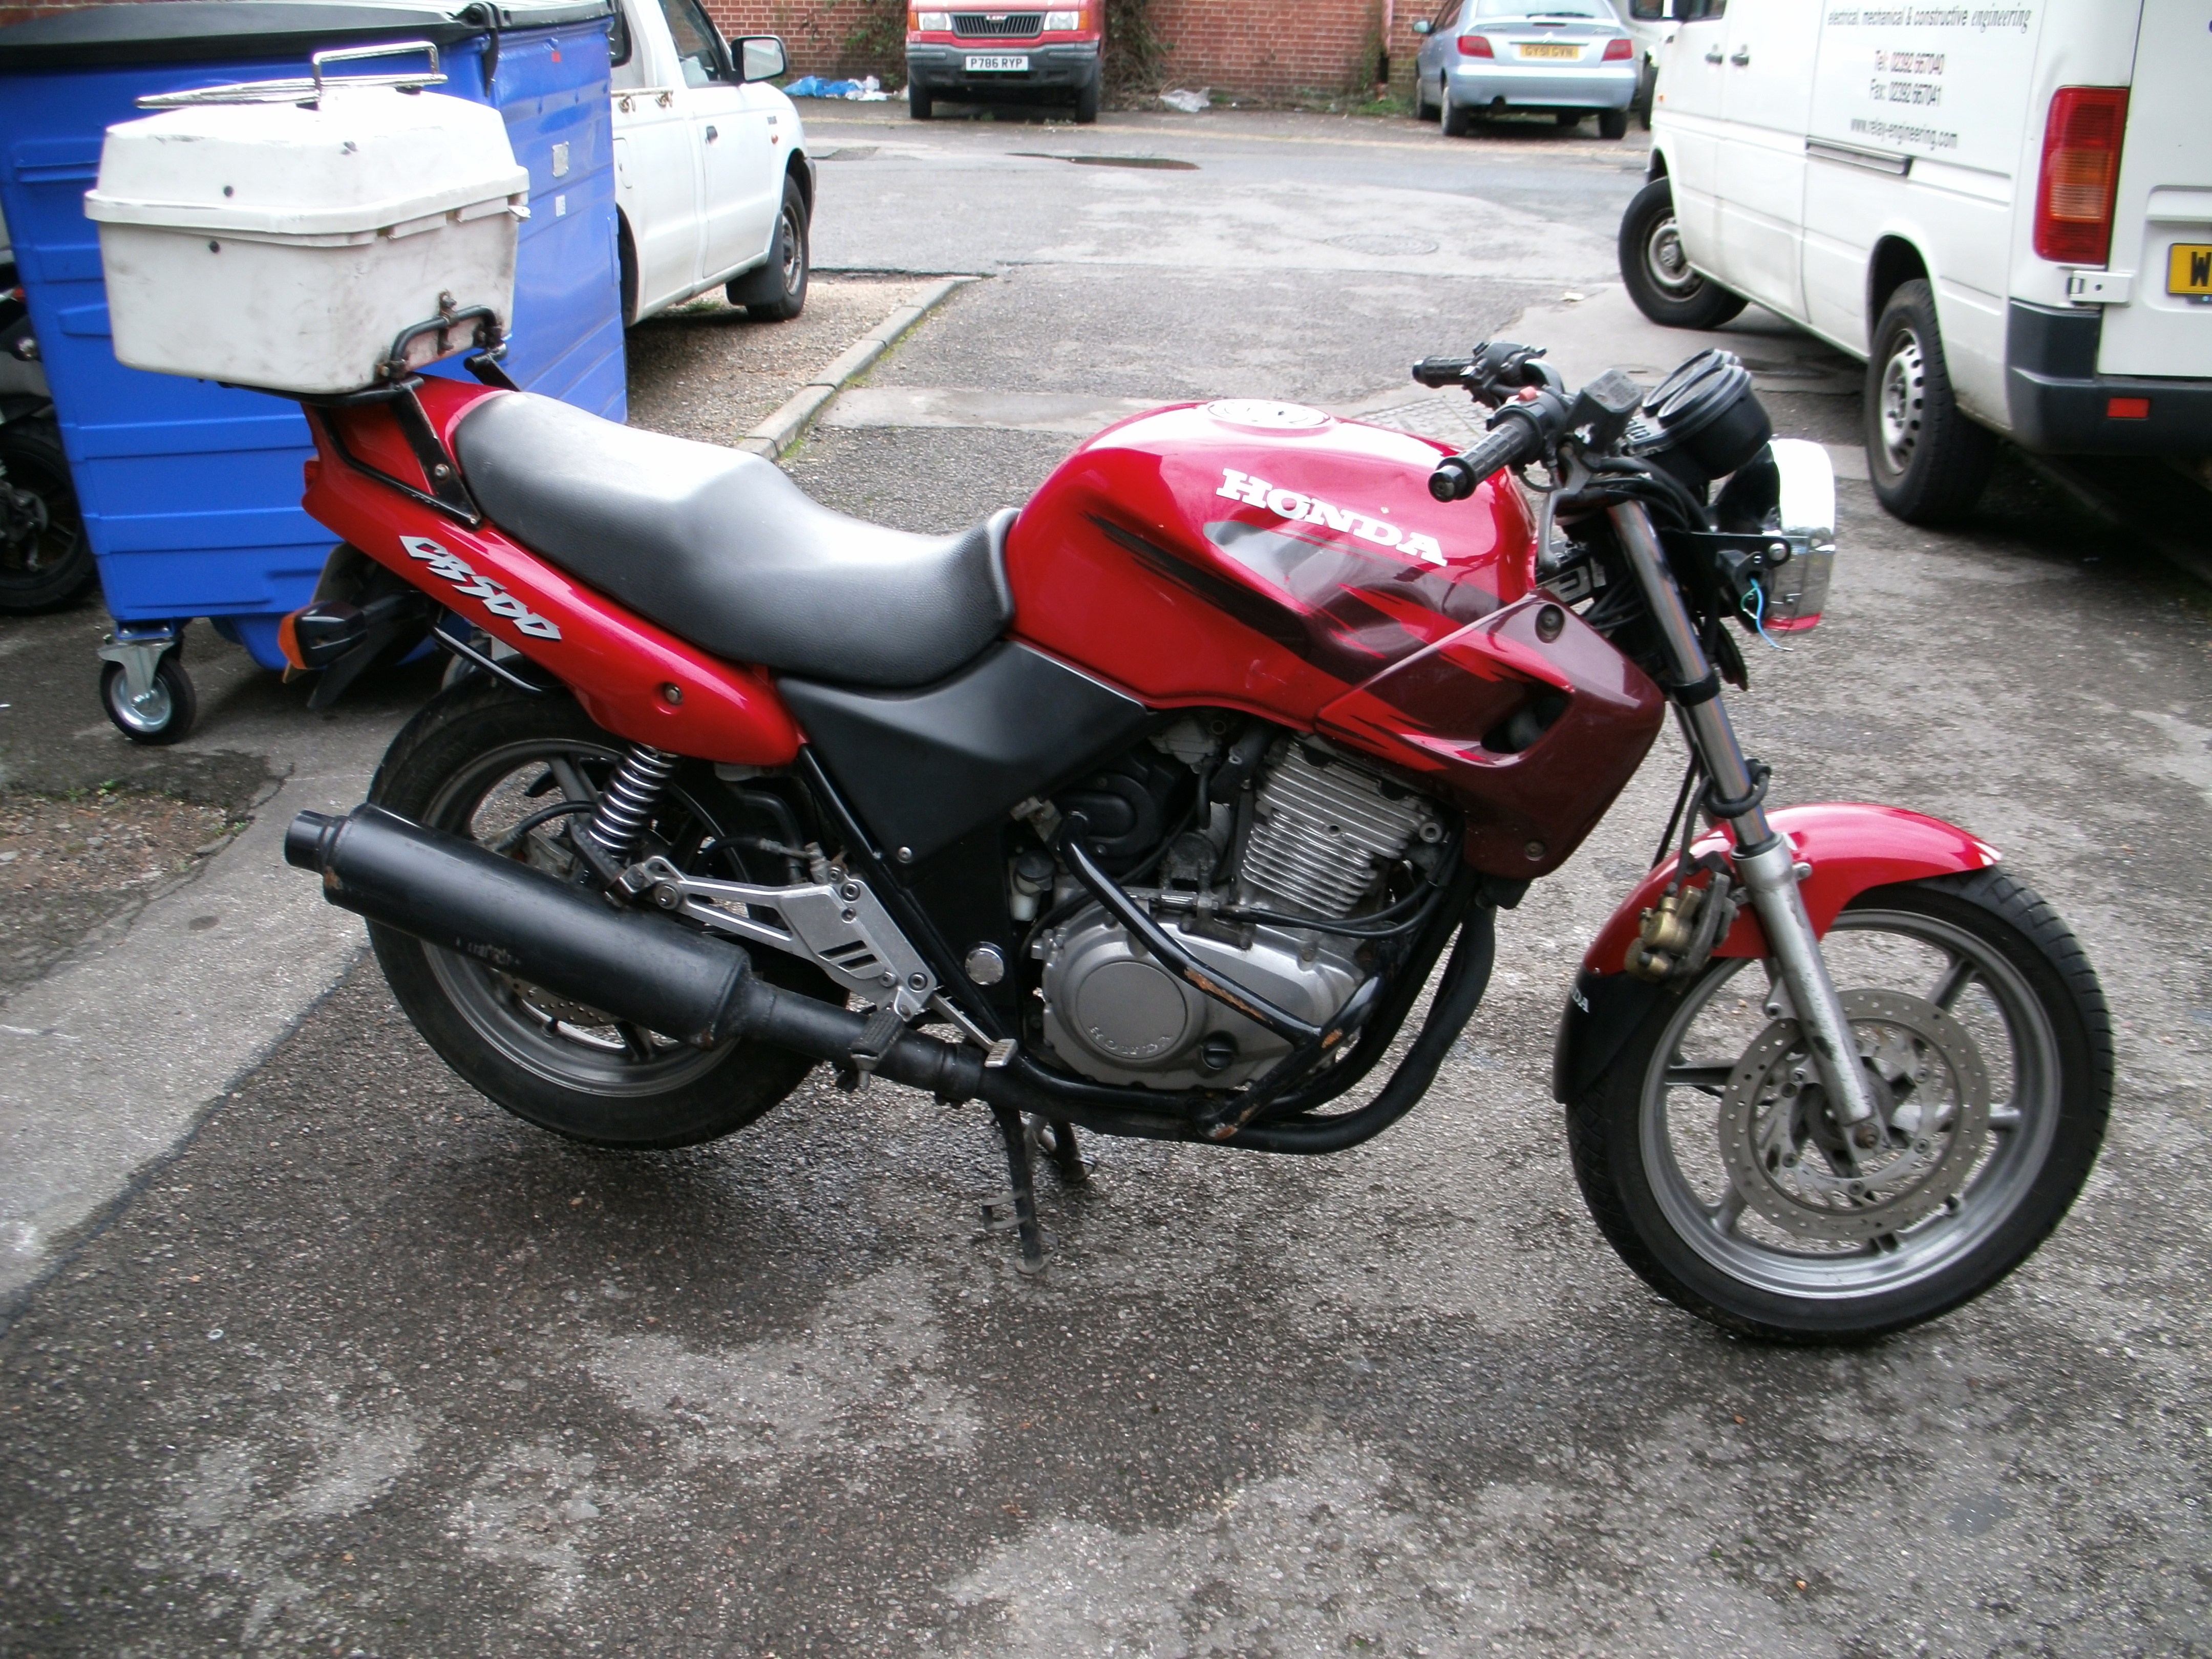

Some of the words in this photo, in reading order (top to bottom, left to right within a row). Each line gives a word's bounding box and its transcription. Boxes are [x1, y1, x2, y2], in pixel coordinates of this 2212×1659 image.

[1863, 7, 1905, 26] mechanical
[1905, 6, 1913, 26] &
[1914, 5, 1967, 26] constructive
[1971, 2, 2032, 34] engineering
[970, 58, 998, 69] P786
[1001, 58, 1022, 69] RYP
[1869, 78, 1887, 100] Fax:
[1850, 117, 1958, 152] www.relay-engineering.com
[1216, 467, 1448, 567] HONDA
[399, 536, 562, 641] CB500
[1089, 1026, 1171, 1056] HONDA
